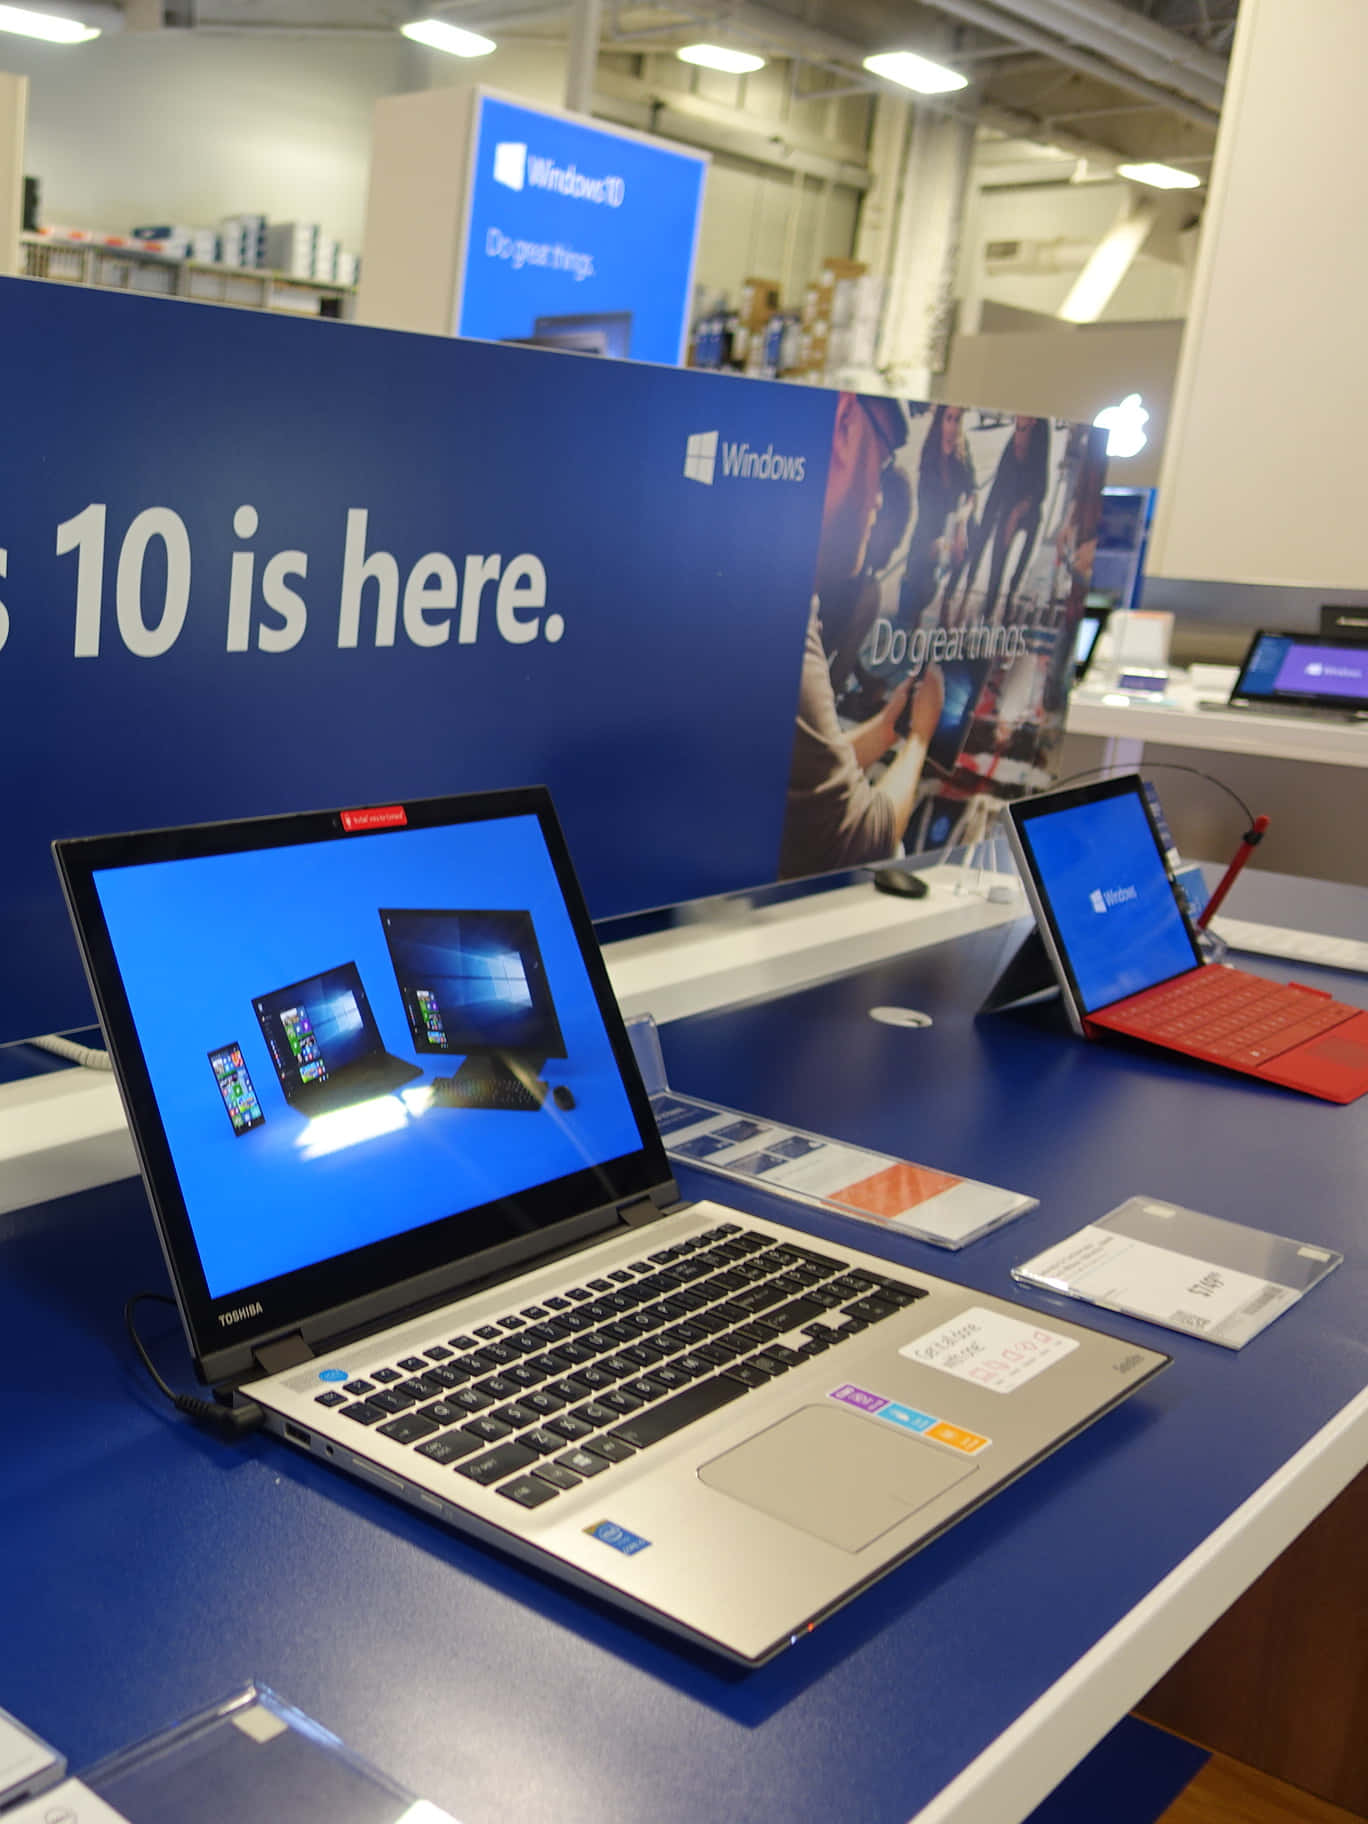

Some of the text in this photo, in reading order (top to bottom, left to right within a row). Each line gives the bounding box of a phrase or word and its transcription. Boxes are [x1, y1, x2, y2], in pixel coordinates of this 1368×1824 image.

[486, 227, 513, 259] Do
[722, 441, 806, 482] Windows
[56, 503, 192, 658] 10
[226, 504, 308, 653] is
[337, 508, 565, 649] here.
[871, 615, 1030, 677] Do great things.
[217, 1300, 264, 1328] TOSHIBA
